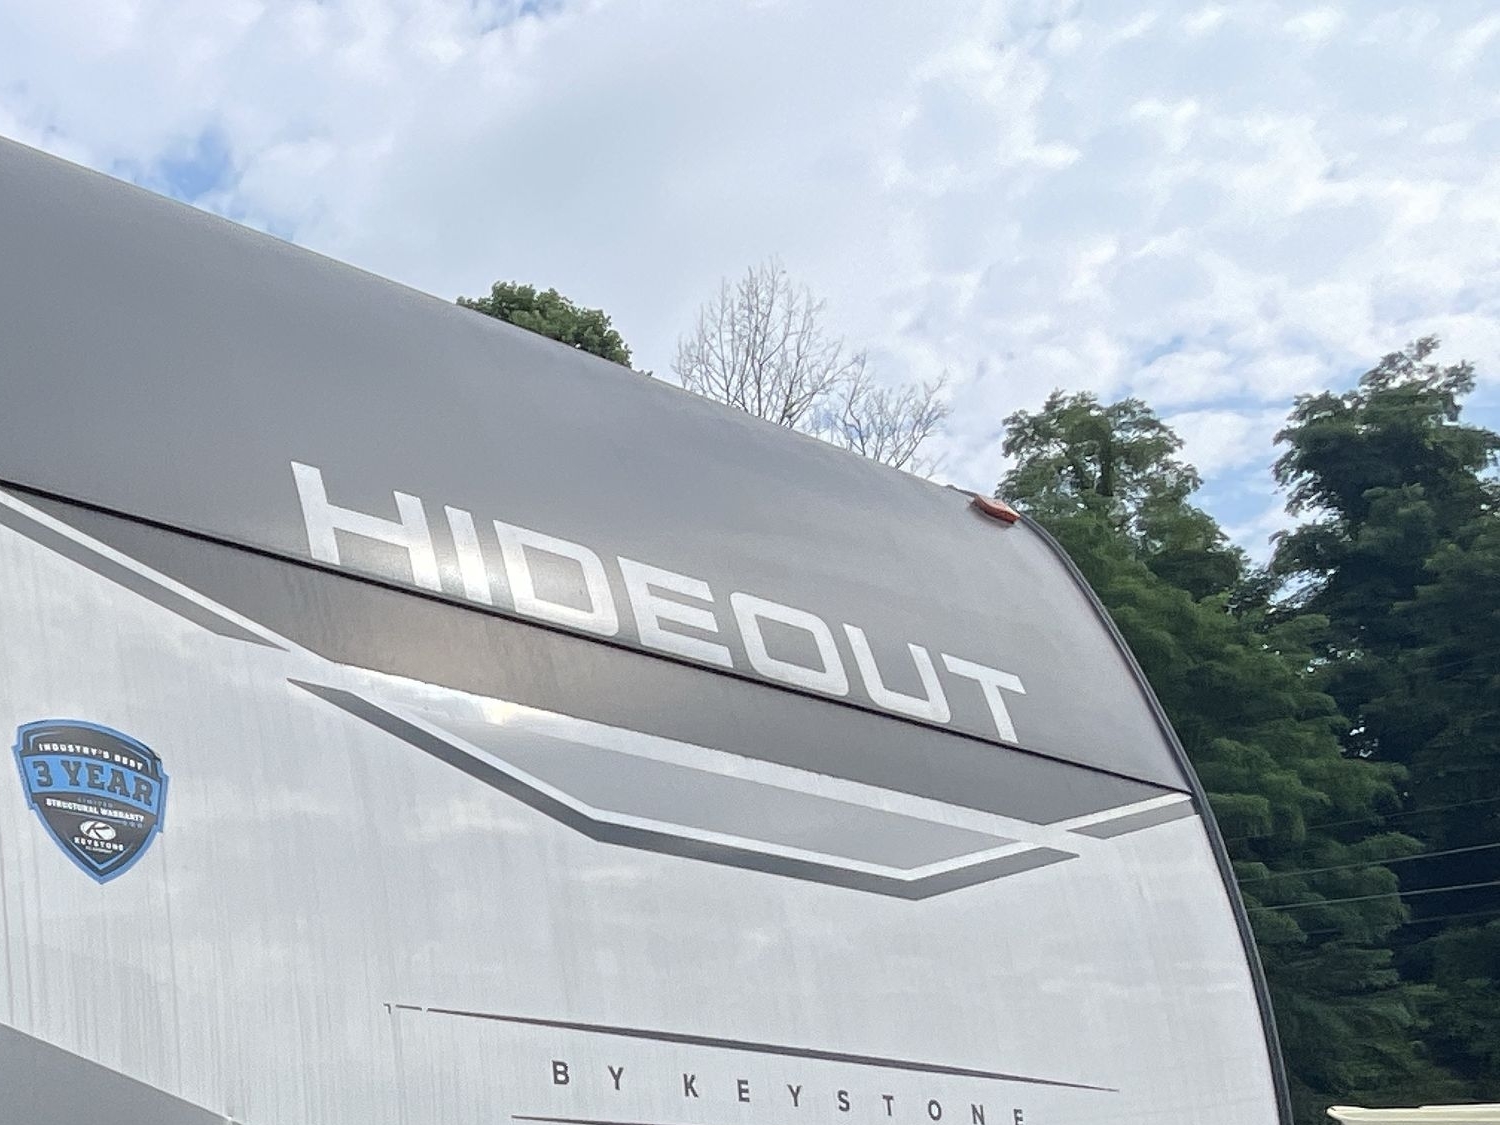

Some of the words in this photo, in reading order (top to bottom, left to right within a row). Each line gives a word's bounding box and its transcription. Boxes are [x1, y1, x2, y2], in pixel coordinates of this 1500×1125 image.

[290, 461, 1027, 744] HIDEOUT
[32, 760, 53, 787] 3
[60, 760, 153, 806] YEAR
[45, 798, 99, 815] STRUCTURAL
[100, 806, 145, 822] WARRANTY
[73, 836, 124, 851] KEYSTONE
[552, 1060, 624, 1091] BY
